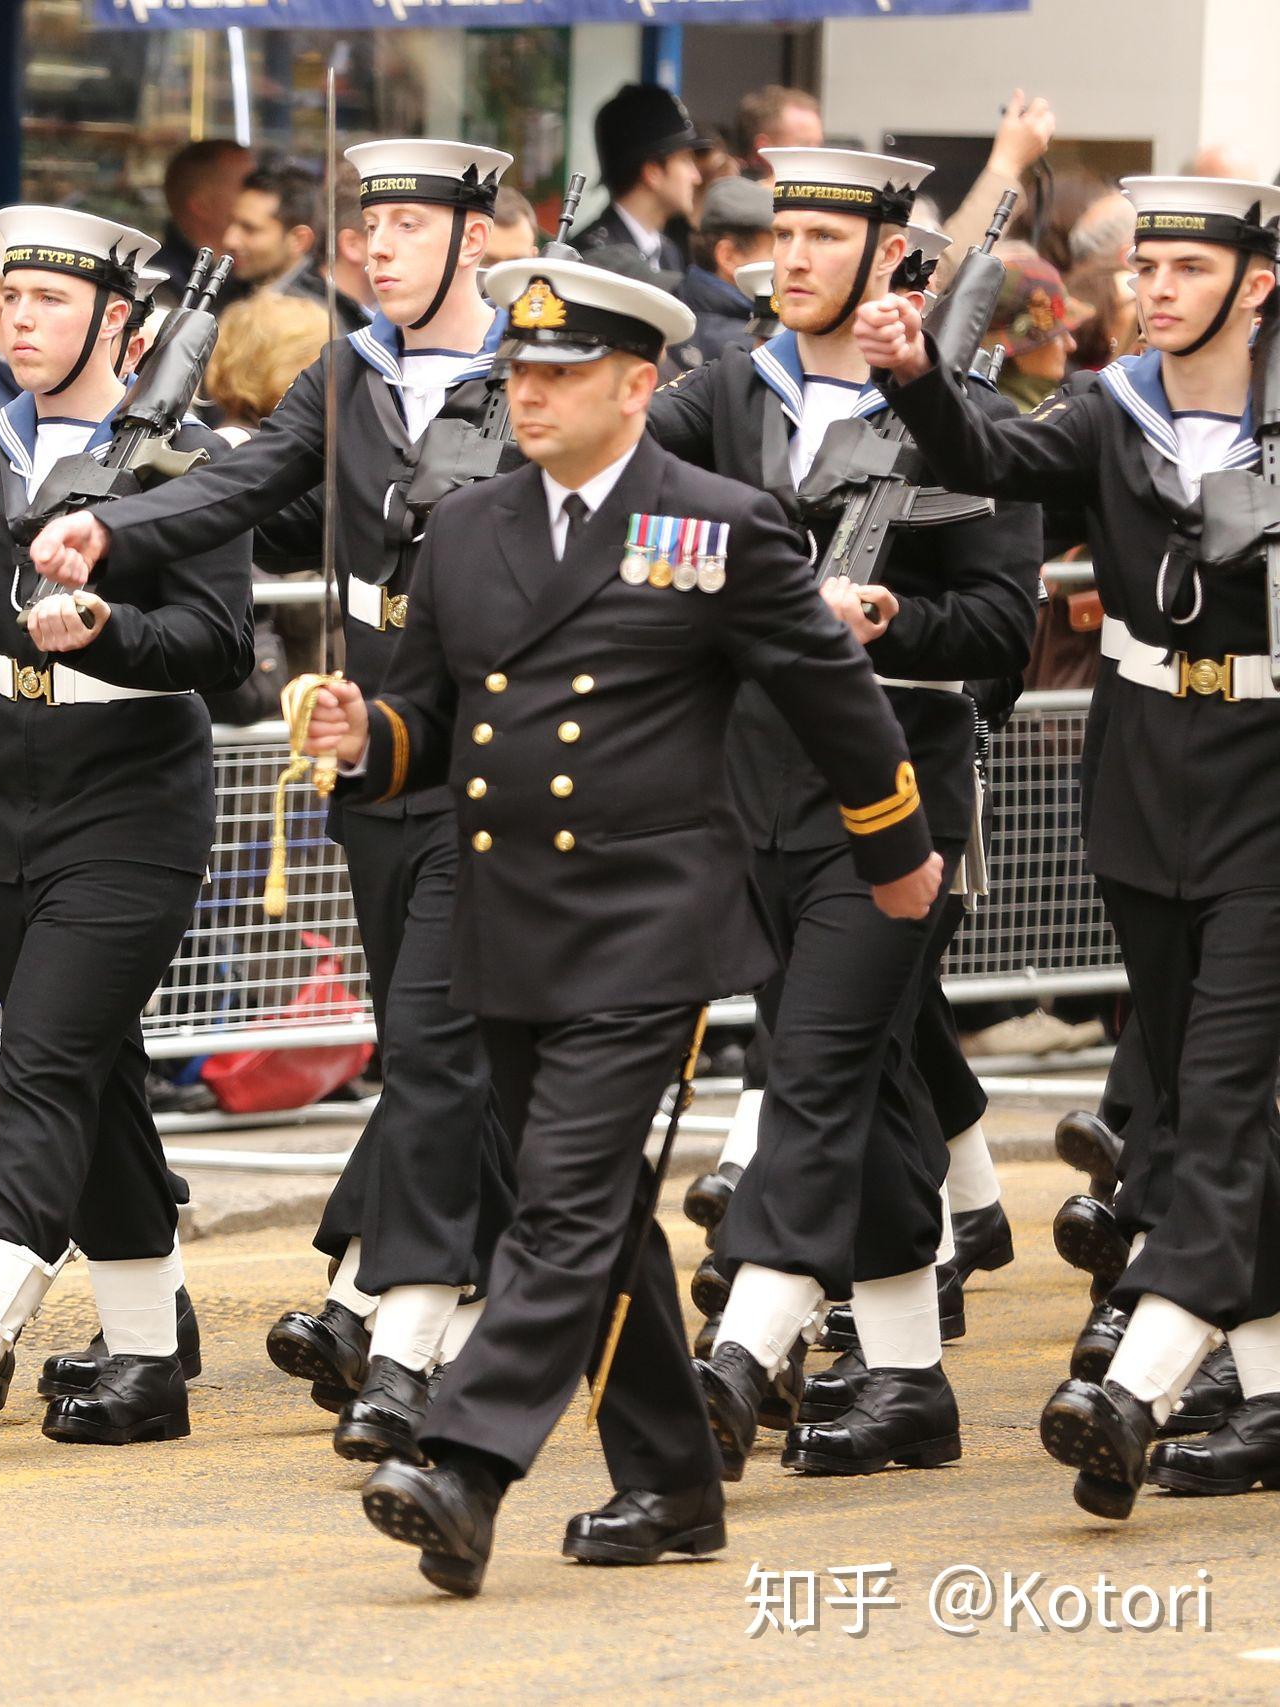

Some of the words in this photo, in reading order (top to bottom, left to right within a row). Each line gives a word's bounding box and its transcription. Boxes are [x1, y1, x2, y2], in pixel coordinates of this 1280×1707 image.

[371, 177, 417, 192] HERON
[787, 185, 873, 203] AMPHIBIOUS
[1153, 215, 1207, 230] HERON
[36, 249, 76, 265] TYPE
[79, 256, 97, 270] 23
